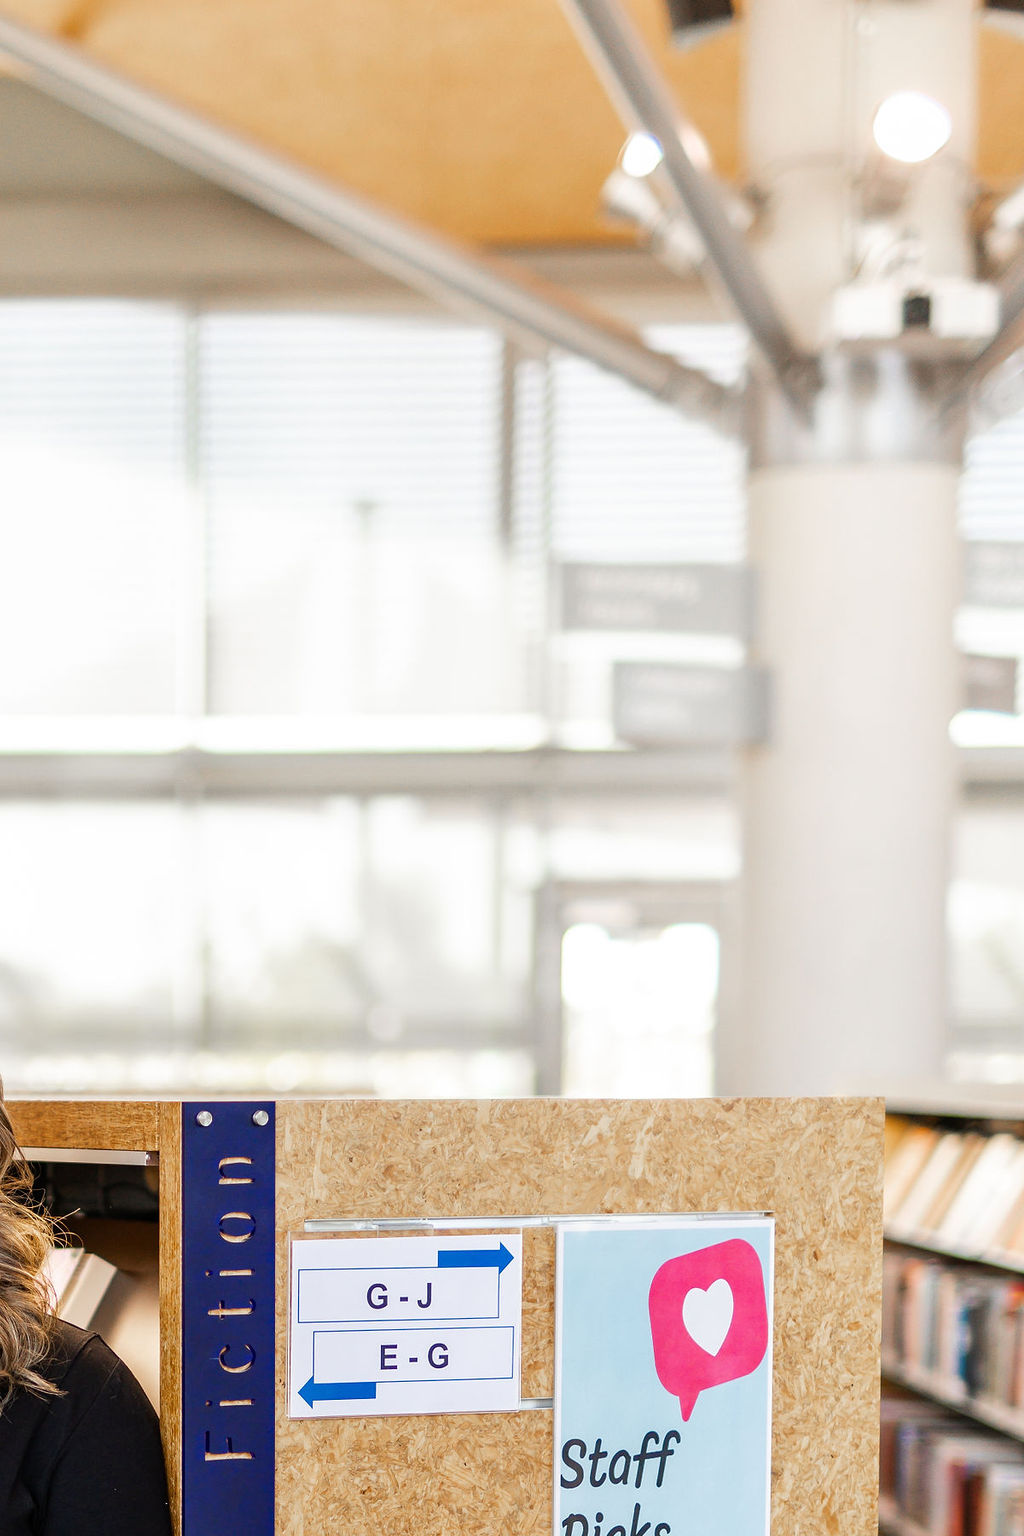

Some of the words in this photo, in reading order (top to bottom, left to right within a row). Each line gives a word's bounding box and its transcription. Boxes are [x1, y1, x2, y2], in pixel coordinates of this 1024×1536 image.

[204, 1156, 256, 1462] Fiction
[366, 1283, 389, 1309] G
[417, 1283, 433, 1309] J
[380, 1344, 397, 1370] E
[427, 1343, 450, 1369] G
[560, 1430, 681, 1489] Staff
